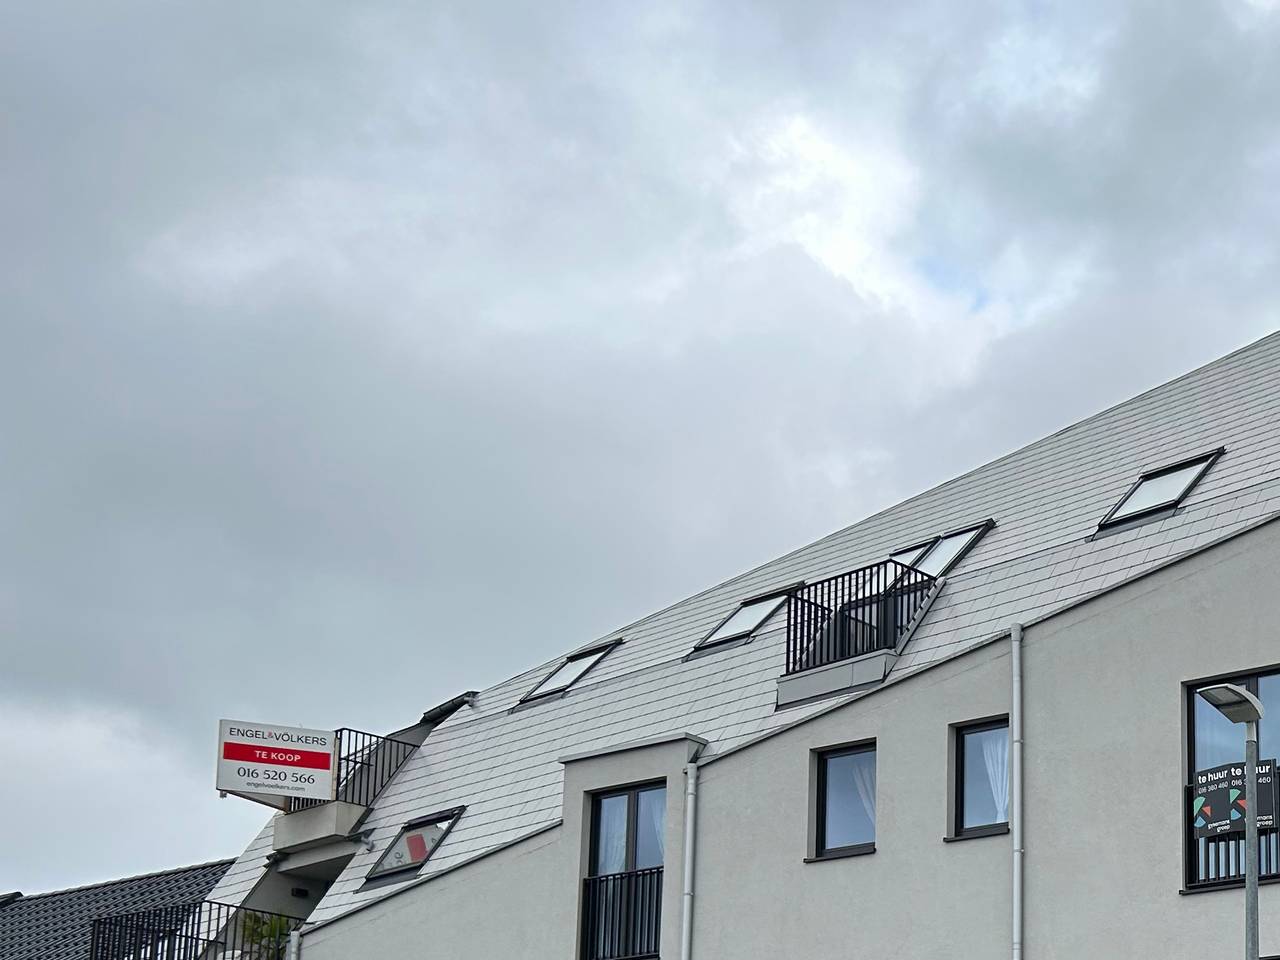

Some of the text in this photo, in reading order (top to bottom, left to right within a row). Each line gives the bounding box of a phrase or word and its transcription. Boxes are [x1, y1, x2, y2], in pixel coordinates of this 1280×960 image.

[254, 750, 301, 762] TE KOOP
[237, 767, 315, 784] 016 520 566
[1198, 770, 1228, 784] te huur
[1230, 767, 1242, 776] te
[246, 781, 306, 792] engelvoelkers.com
[1231, 779, 1243, 787] 016
